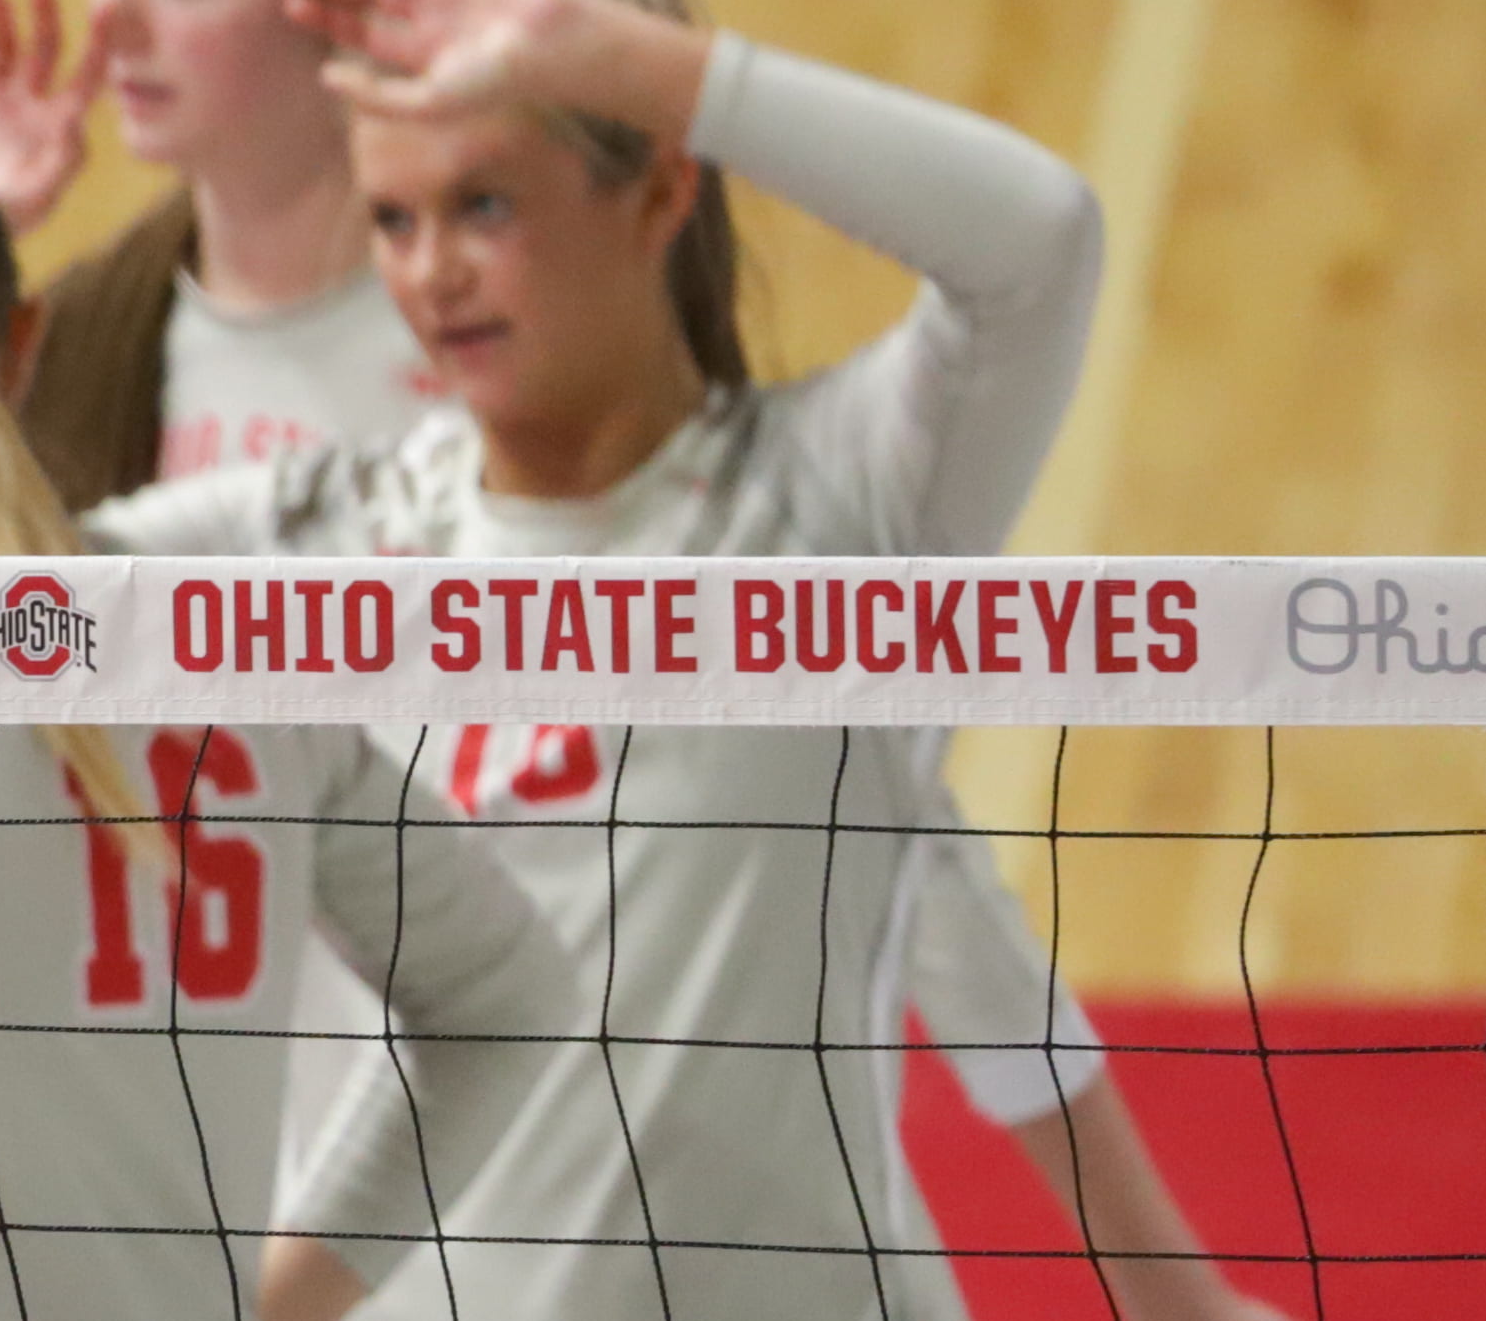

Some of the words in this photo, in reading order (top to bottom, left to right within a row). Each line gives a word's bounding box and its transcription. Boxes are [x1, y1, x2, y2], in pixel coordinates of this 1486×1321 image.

[173, 580, 394, 672] OHIO
[431, 579, 697, 673] STATE
[734, 579, 1197, 673] BUCKEYES
[61, 724, 265, 1006] 16
